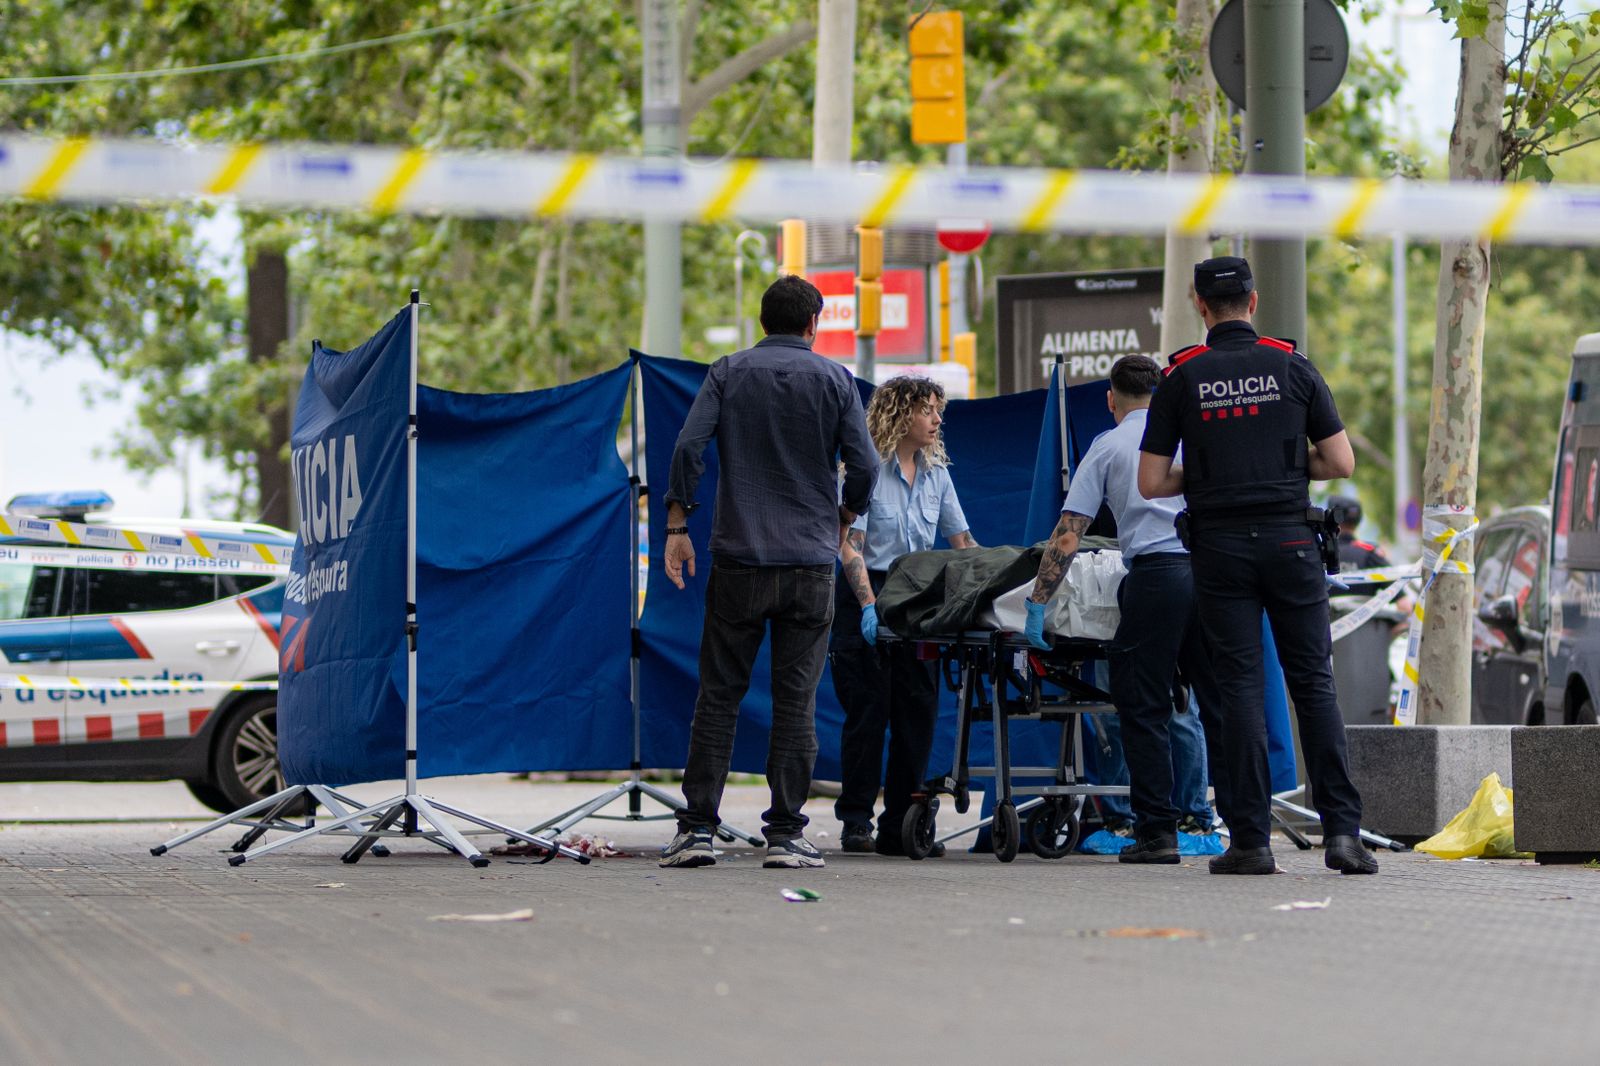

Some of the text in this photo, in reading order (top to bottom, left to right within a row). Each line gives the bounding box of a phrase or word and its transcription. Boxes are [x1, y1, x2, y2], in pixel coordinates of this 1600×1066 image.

[1041, 329, 1140, 354] ALIMENTA
[1198, 375, 1280, 399] POLICIA
[1200, 391, 1281, 410] mossos d'esquadra
[291, 434, 363, 547] LICIA
[145, 555, 241, 571] no passeu
